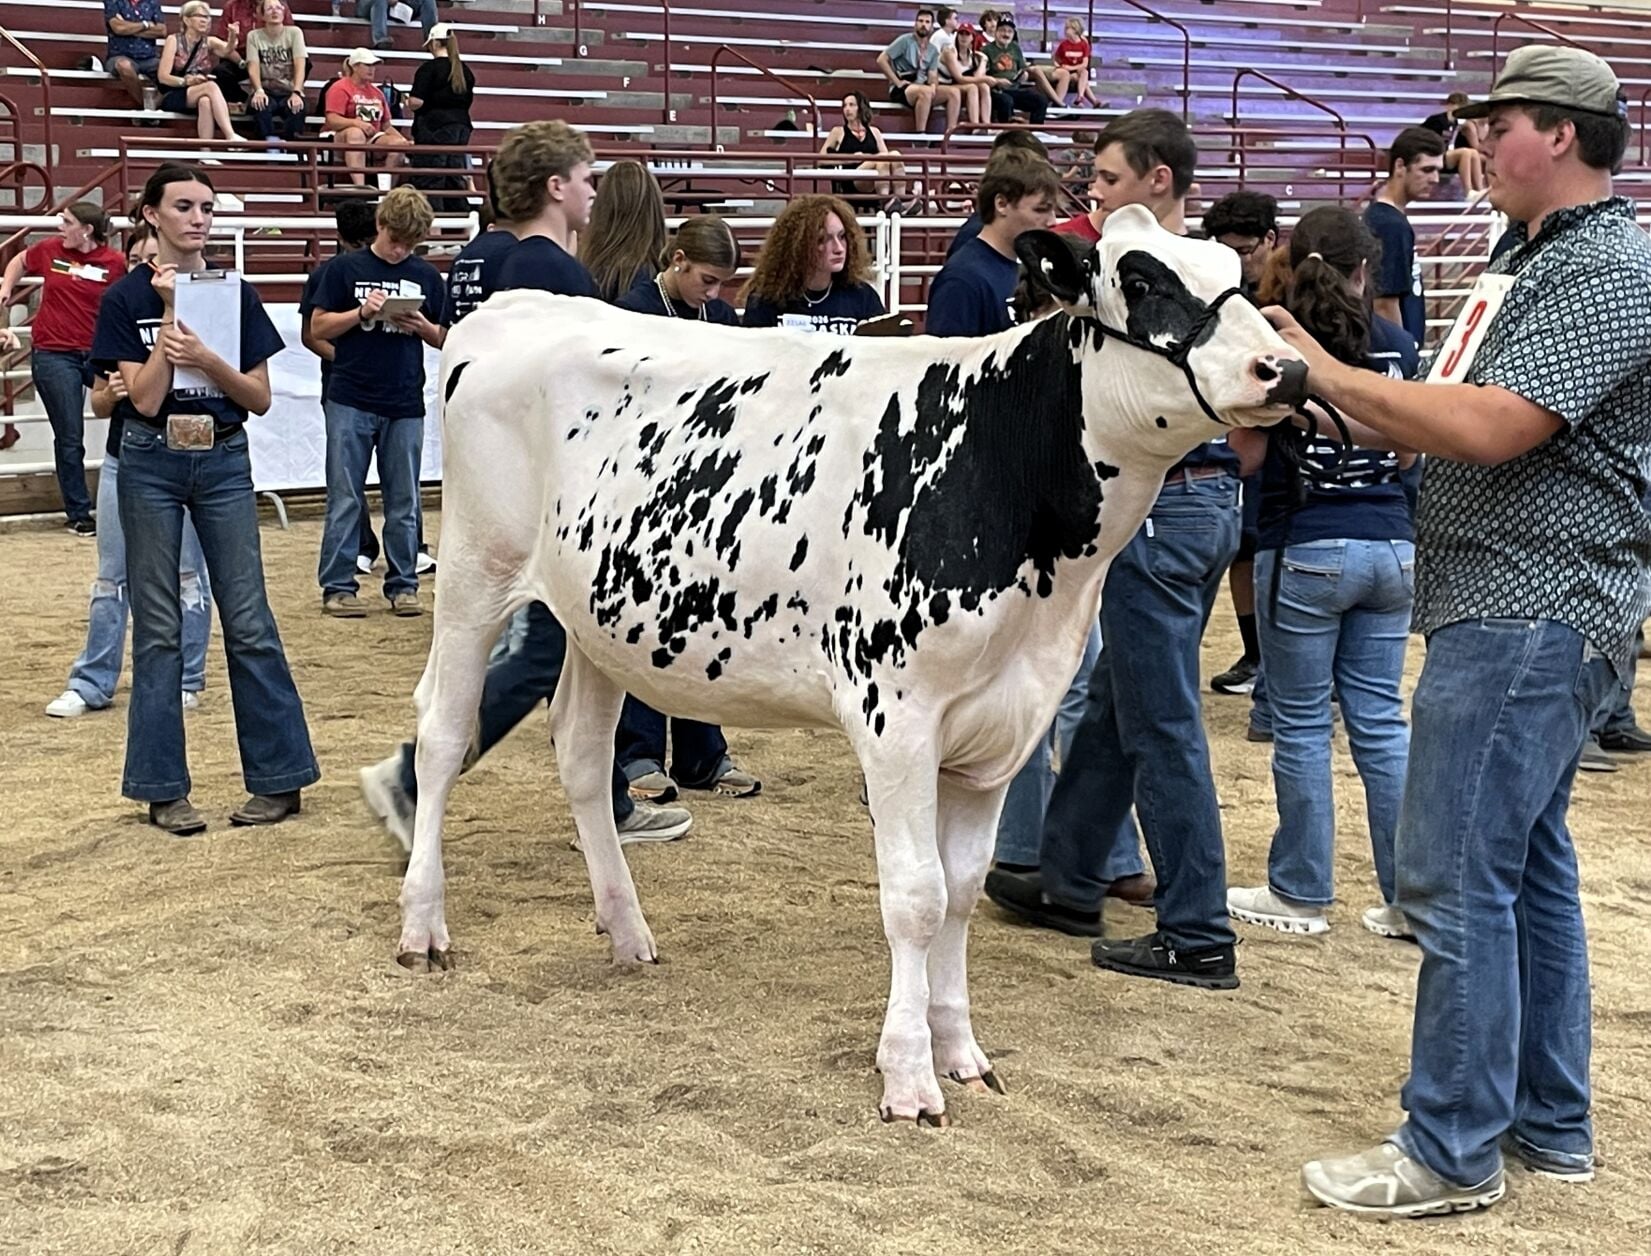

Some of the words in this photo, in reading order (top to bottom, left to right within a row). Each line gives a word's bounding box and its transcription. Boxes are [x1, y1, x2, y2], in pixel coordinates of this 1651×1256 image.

[538, 15, 546, 25] H
[579, 45, 588, 56] G
[623, 77, 631, 88] F
[669, 110, 677, 122] E
[1285, 185, 1293, 196] C
[1440, 300, 1488, 378] 3
